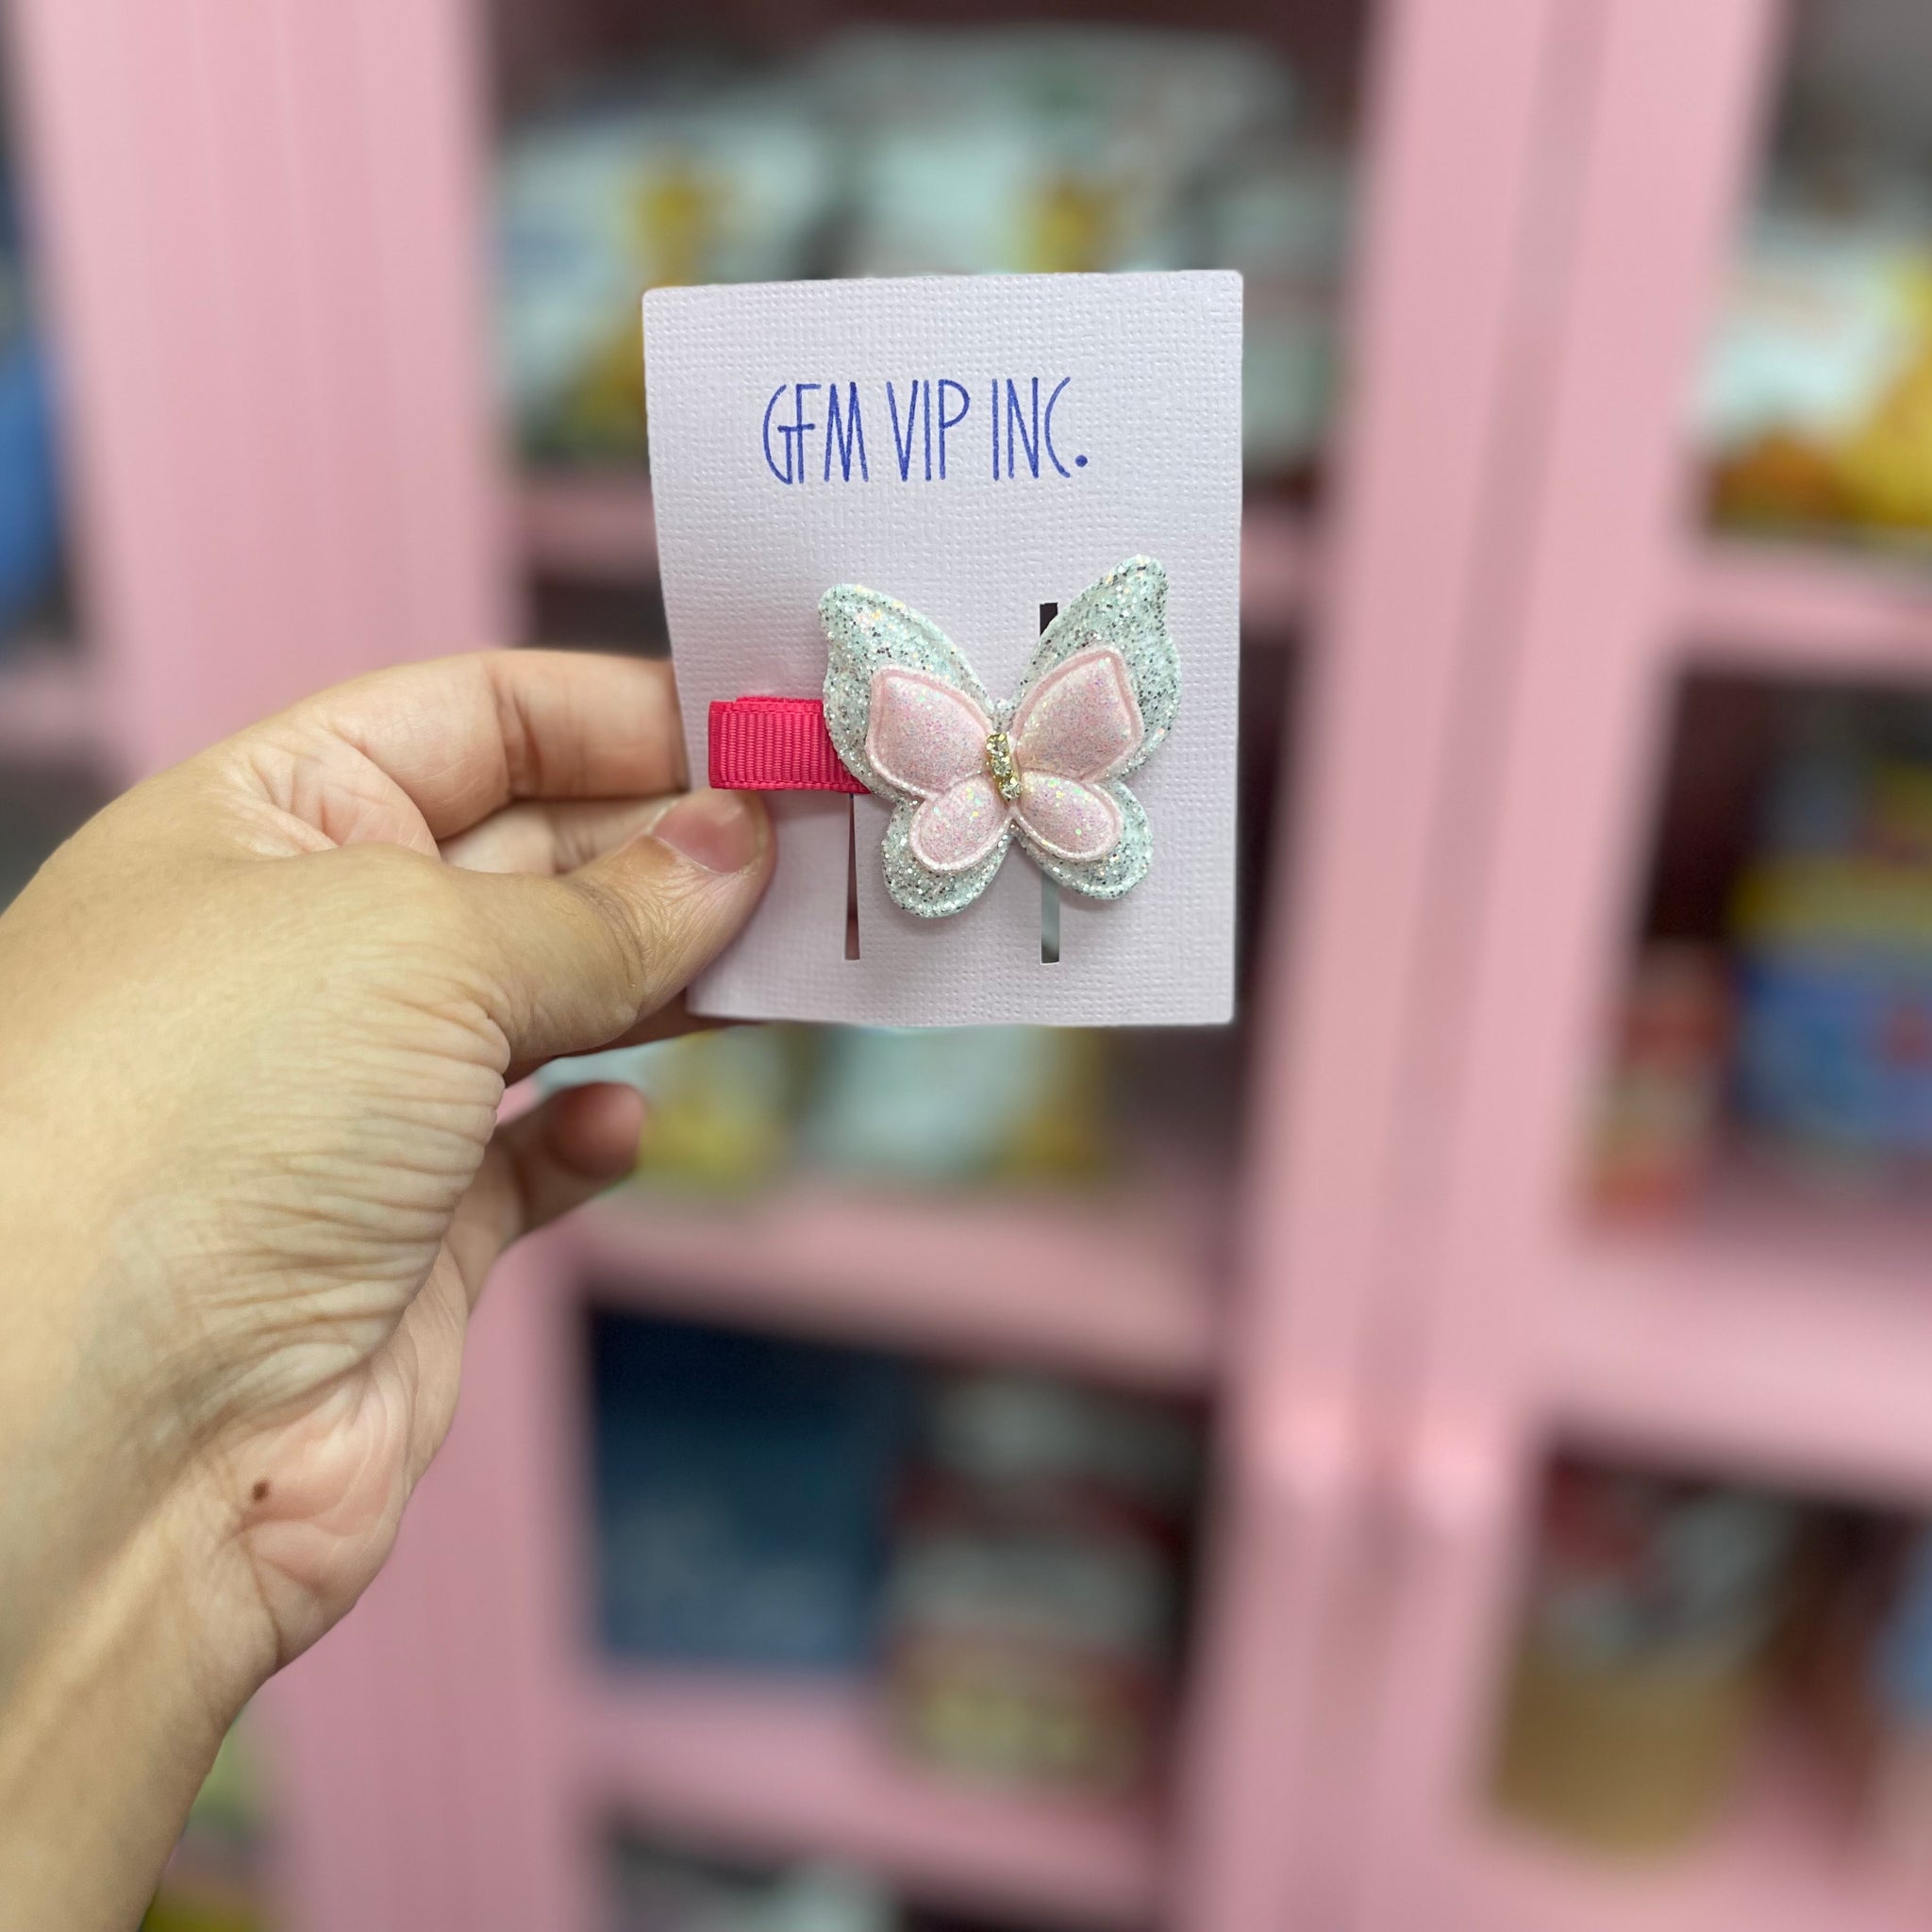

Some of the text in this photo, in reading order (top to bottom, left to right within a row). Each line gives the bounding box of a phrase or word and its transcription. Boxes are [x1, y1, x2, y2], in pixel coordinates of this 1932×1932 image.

[762, 376, 1089, 485] GFM VIP INC.
